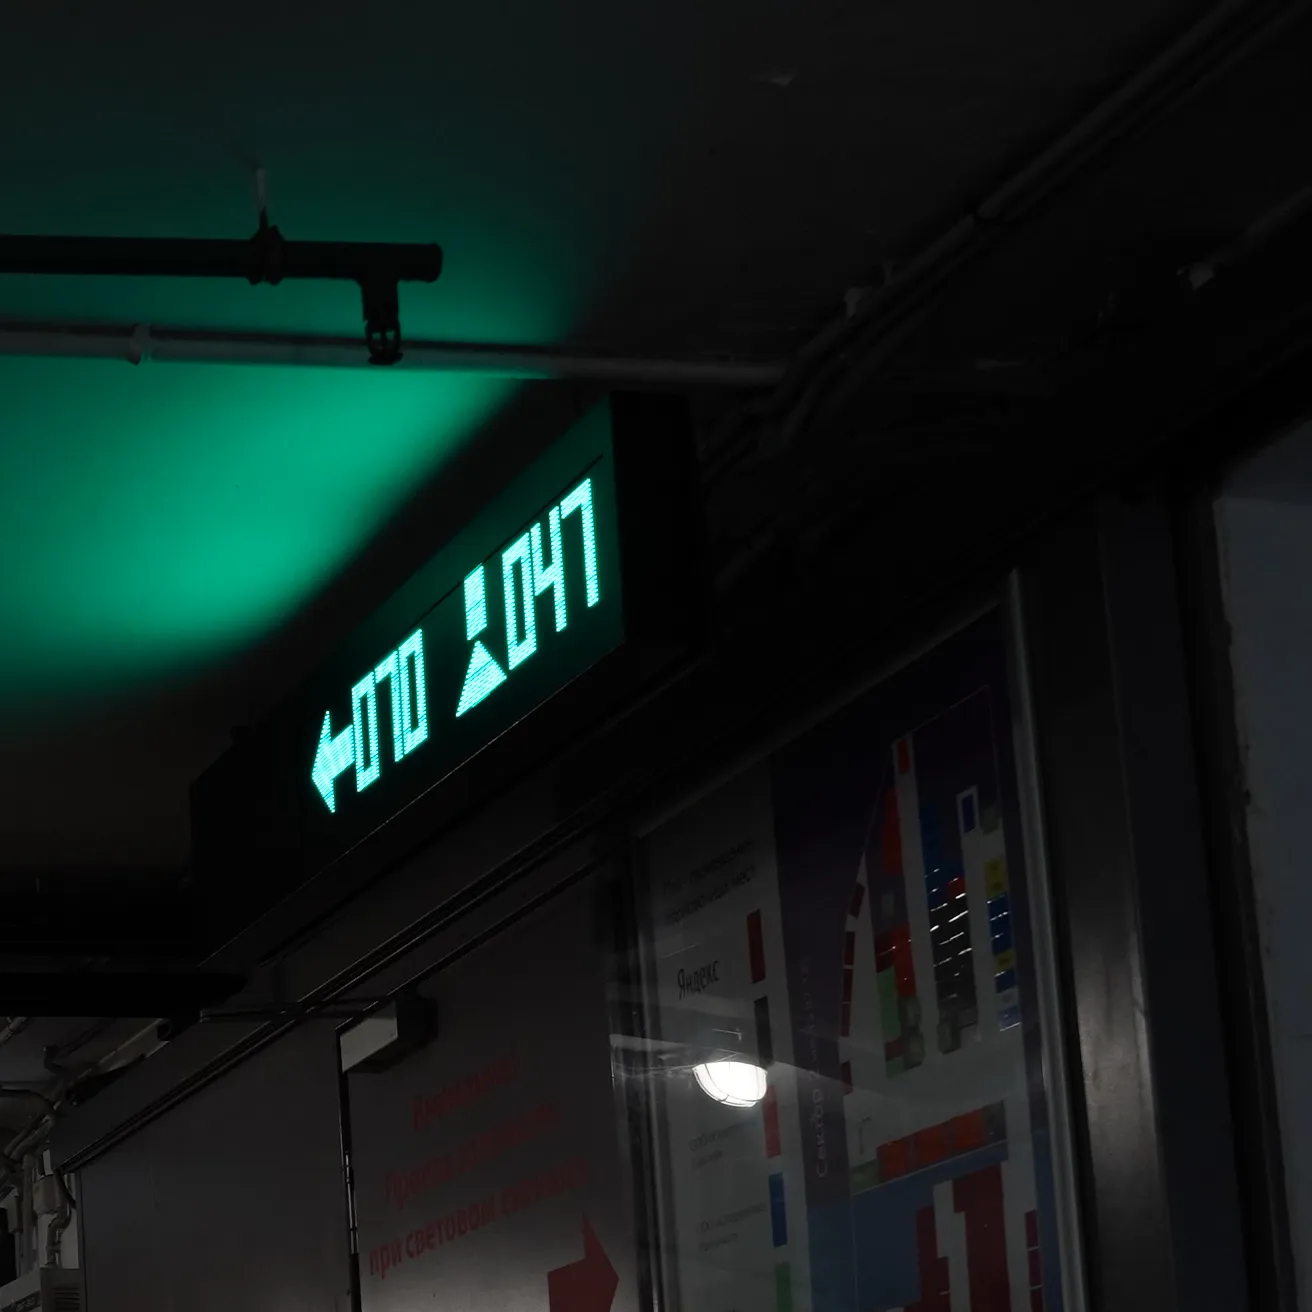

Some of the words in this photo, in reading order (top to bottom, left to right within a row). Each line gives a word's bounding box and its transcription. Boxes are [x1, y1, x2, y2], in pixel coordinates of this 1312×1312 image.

[350, 629, 429, 793] 070
[501, 478, 599, 671] 047
[677, 960, 720, 1000] Яндекс
[369, 1237, 401, 1280] при
[406, 1196, 496, 1259] световом
